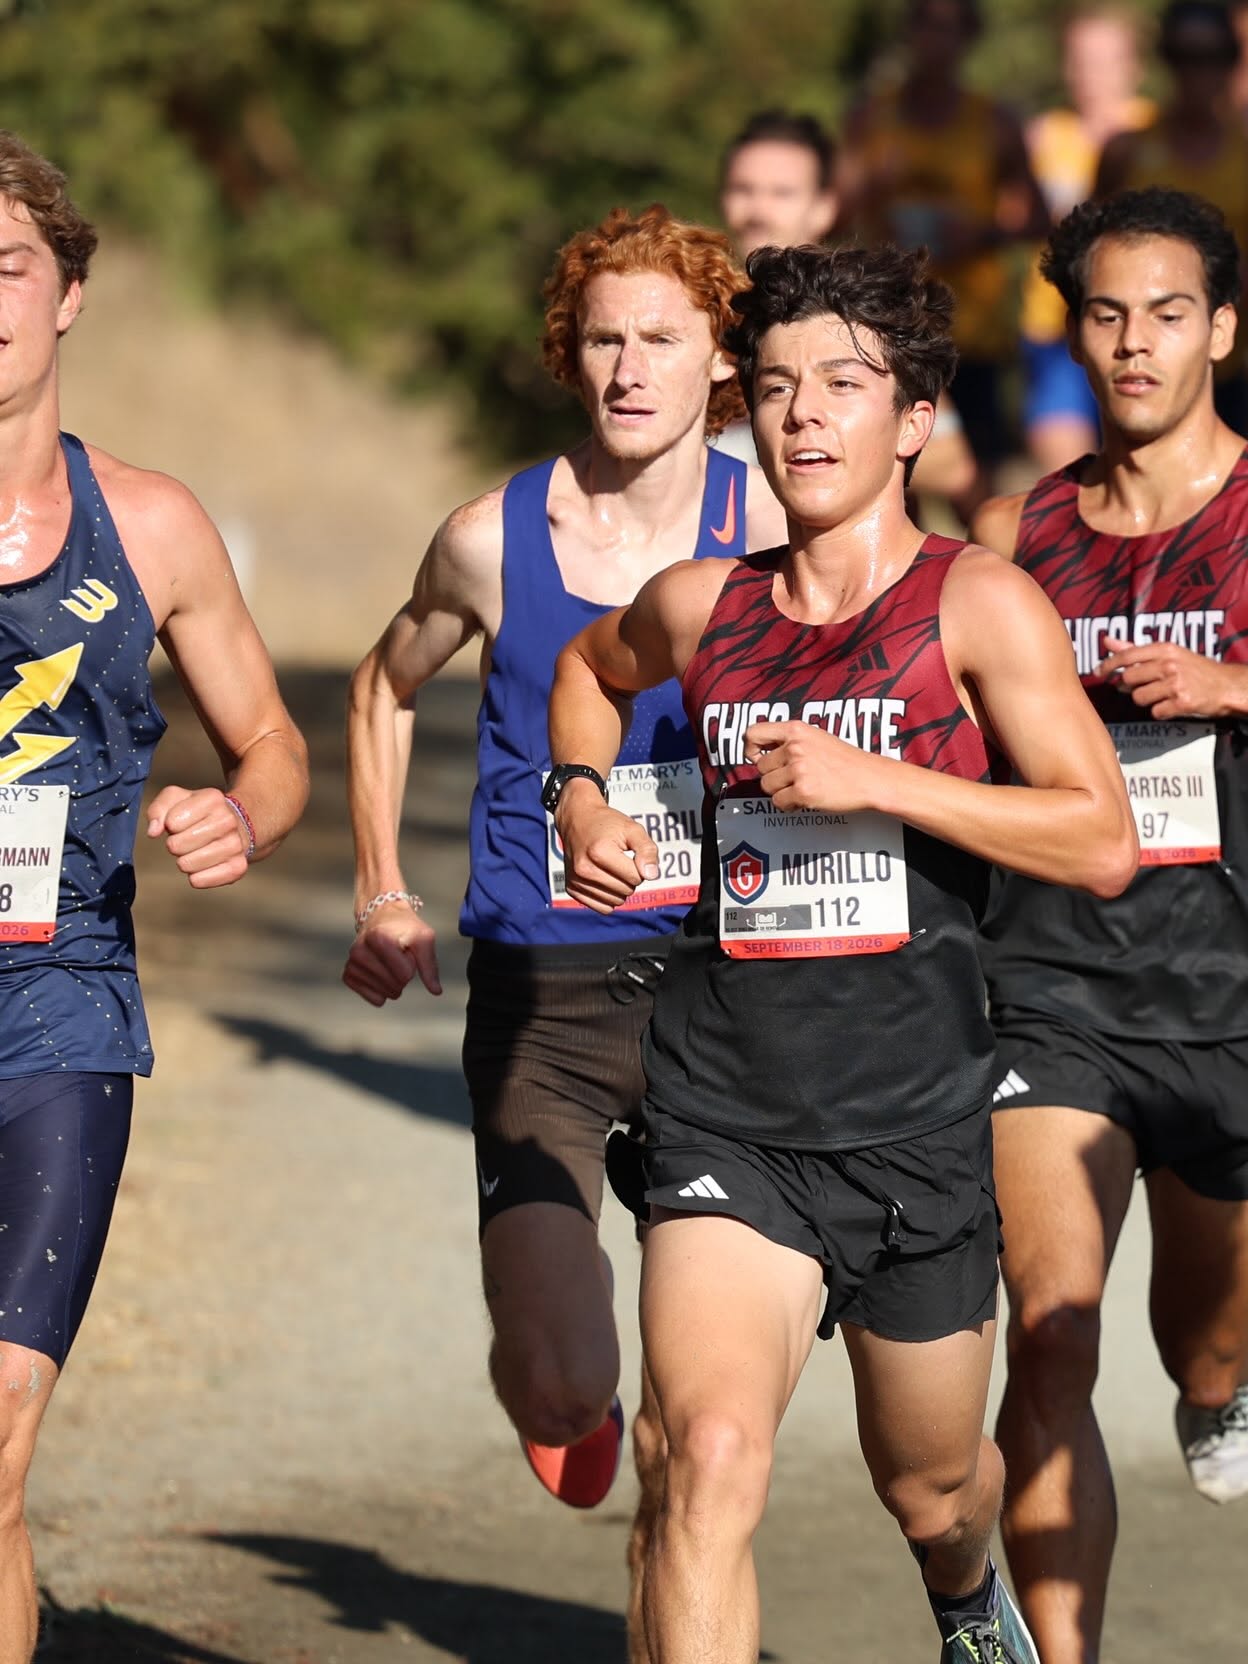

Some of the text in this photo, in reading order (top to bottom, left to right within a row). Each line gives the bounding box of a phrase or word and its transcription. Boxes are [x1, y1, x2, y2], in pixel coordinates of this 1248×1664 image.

[629, 761, 694, 780] MARY'S
[608, 780, 679, 793] ITATIONAL
[1128, 775, 1204, 798] ARTAS III
[764, 815, 849, 828] INVITATIONAL
[1142, 811, 1169, 839] 97
[0, 847, 50, 867] MANN
[657, 850, 692, 880] 20
[737, 861, 754, 891] G
[782, 850, 892, 886] MURILLO
[680, 887, 697, 898] 20
[726, 911, 738, 920] 112
[815, 896, 861, 927] 112
[0, 924, 29, 936] 026
[744, 937, 883, 954] SEPTEMBER 18 2026
